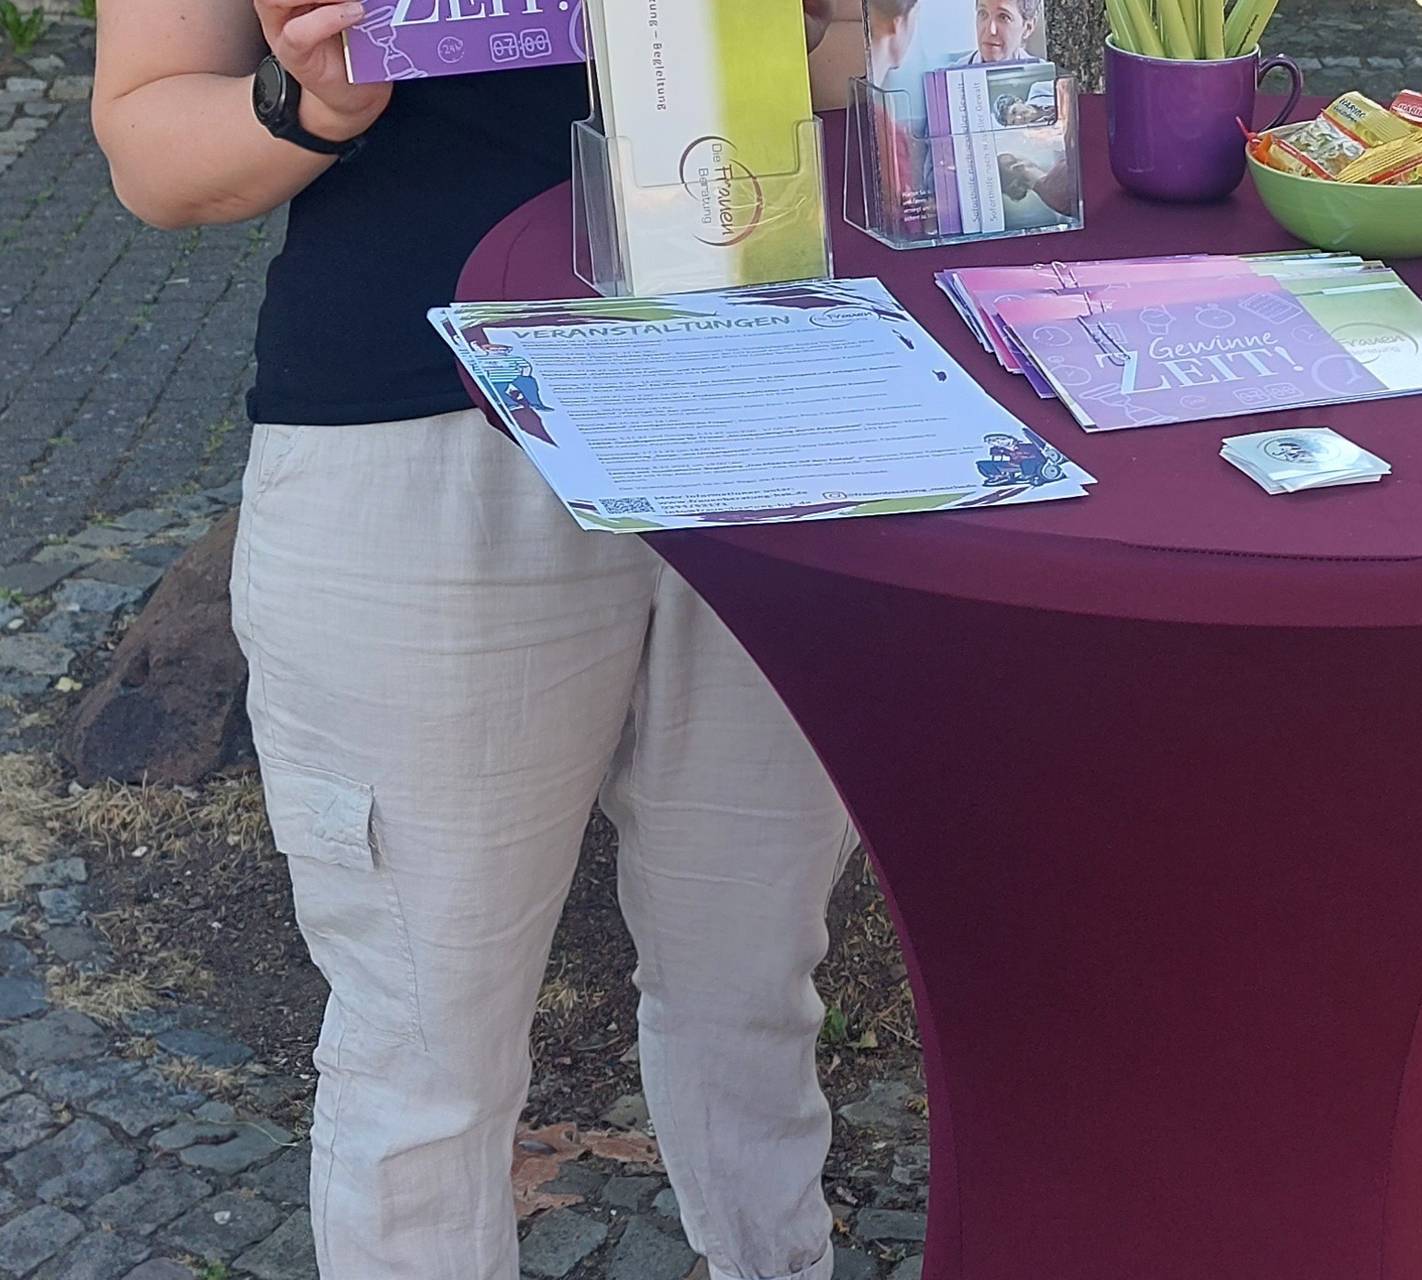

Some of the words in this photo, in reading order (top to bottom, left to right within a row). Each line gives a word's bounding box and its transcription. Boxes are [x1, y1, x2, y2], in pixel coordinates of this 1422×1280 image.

[652, 43, 667, 111] Begleitung
[711, 143, 723, 163] Die
[698, 168, 712, 225] Beratung
[715, 164, 736, 236] Frauen
[512, 315, 790, 341] VERANSTALTUNGEN
[1149, 332, 1279, 359] Gewinne
[1094, 346, 1304, 395] ZEIT!
